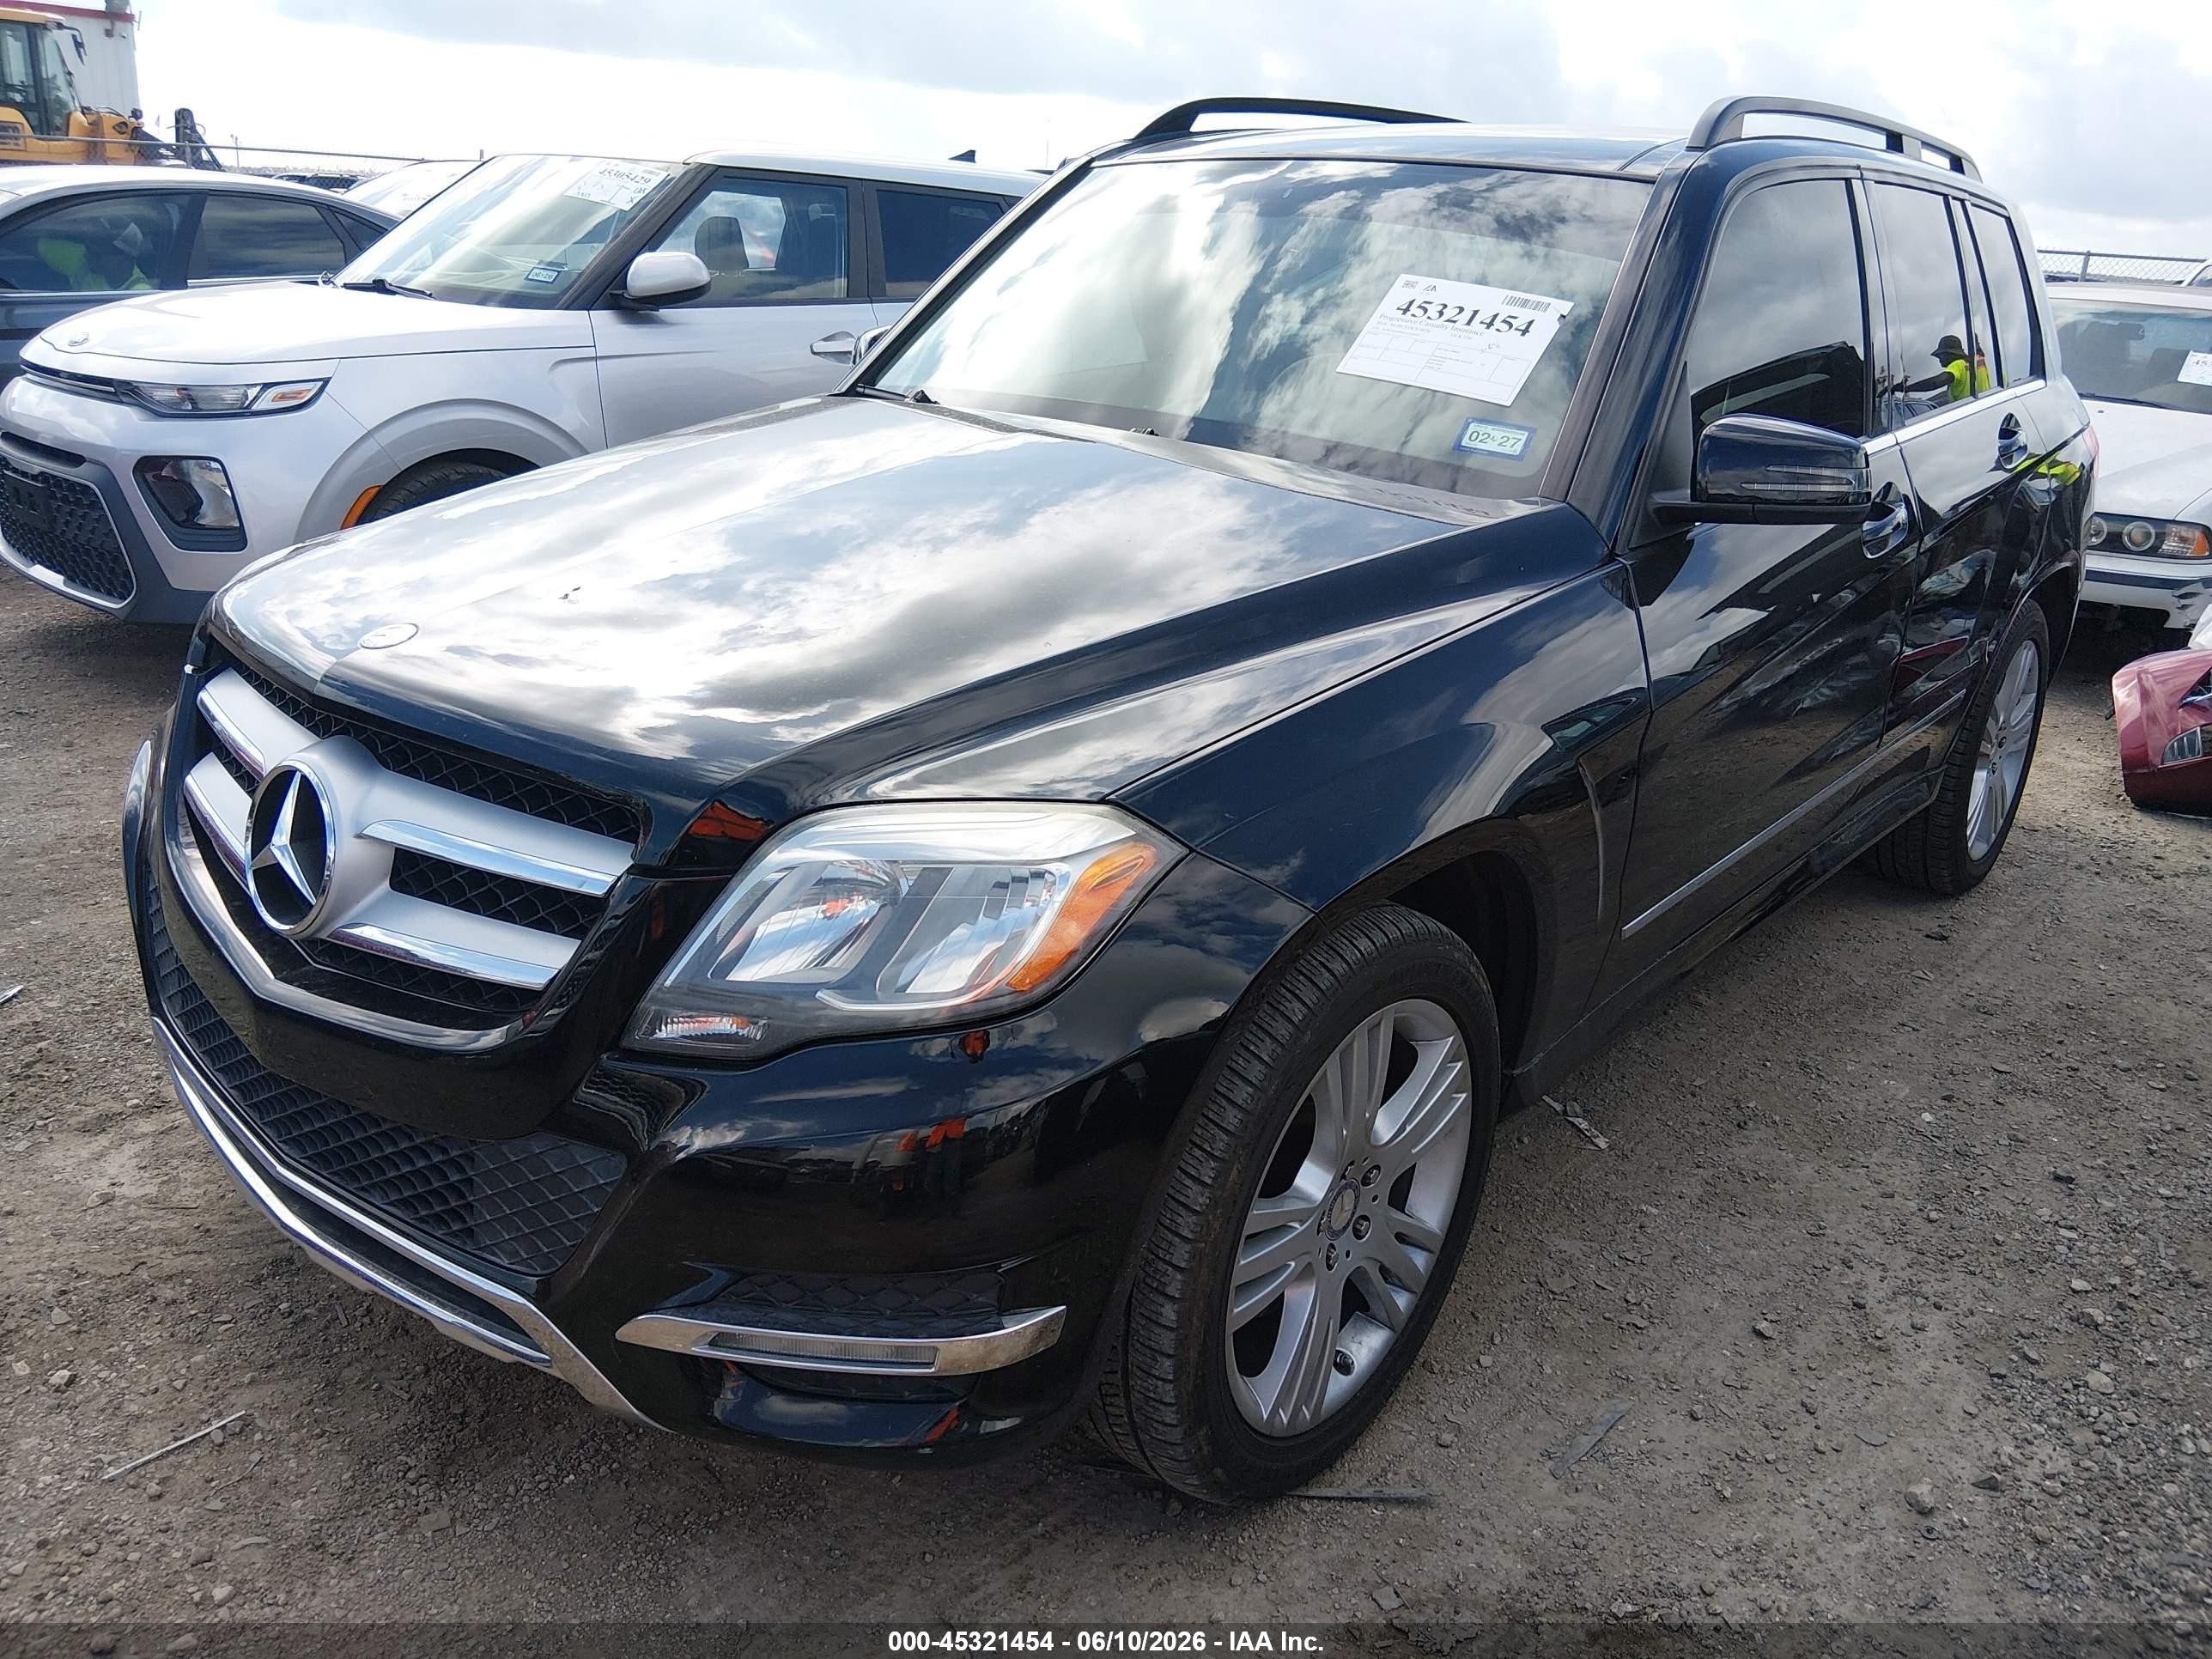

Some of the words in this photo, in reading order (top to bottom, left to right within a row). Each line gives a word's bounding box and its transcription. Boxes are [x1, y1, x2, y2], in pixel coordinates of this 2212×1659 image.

[1379, 313, 1420, 325] Progressive
[1420, 318, 1449, 331] Casualty
[1450, 324, 1485, 337] Insurance
[1396, 298, 1536, 337] 45321454
[1468, 430, 1492, 444] 02
[1498, 435, 1523, 448] 27
